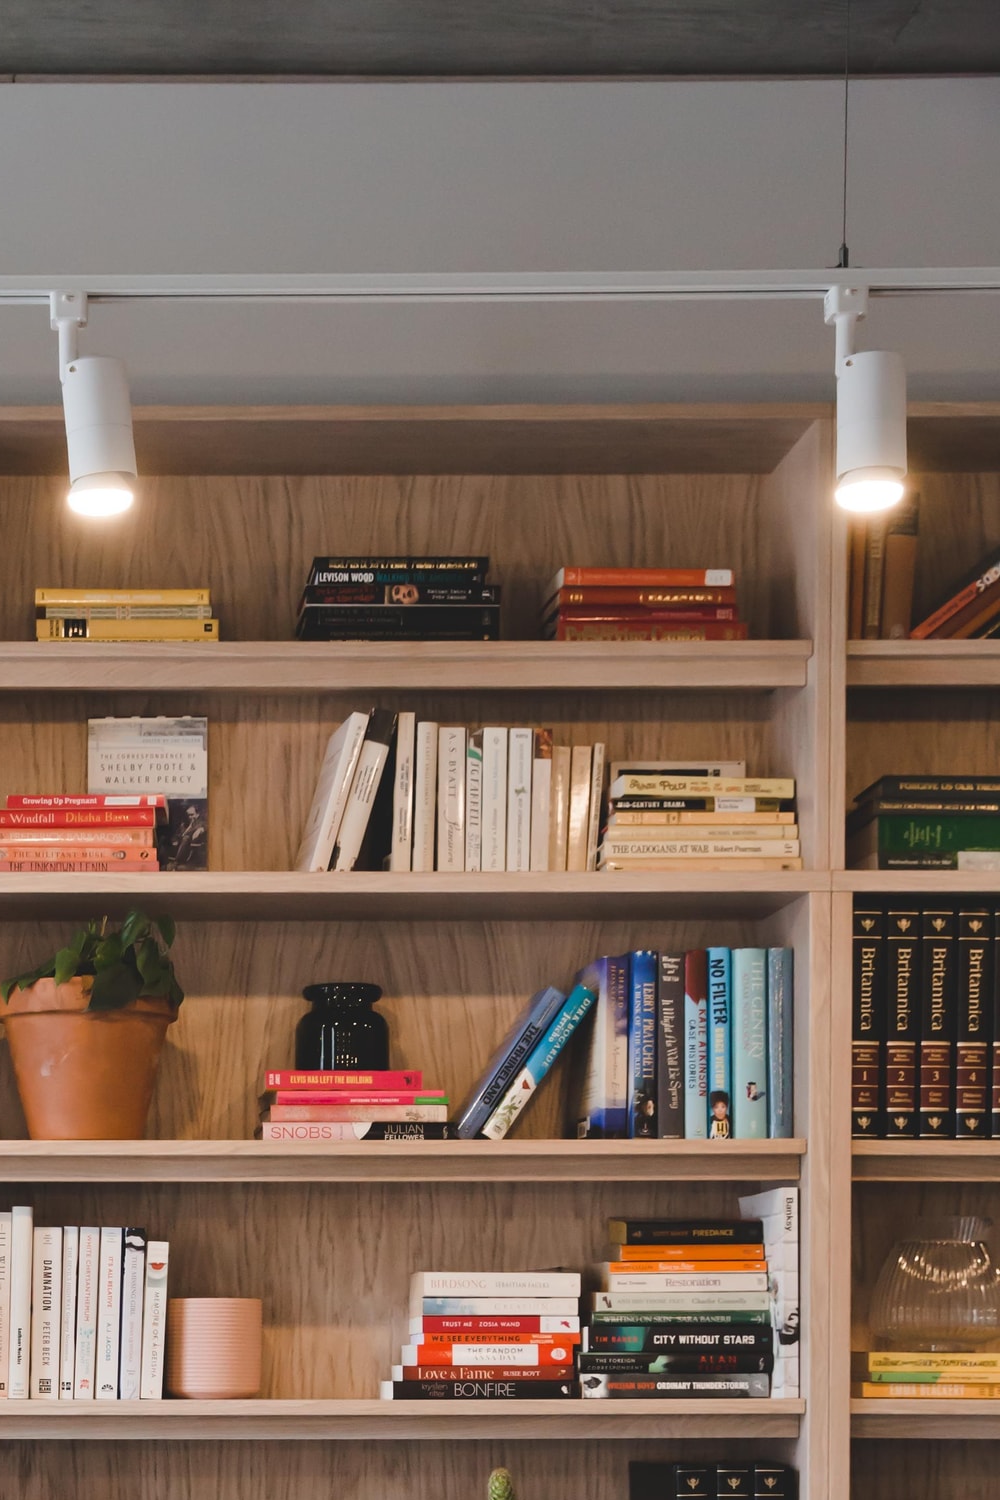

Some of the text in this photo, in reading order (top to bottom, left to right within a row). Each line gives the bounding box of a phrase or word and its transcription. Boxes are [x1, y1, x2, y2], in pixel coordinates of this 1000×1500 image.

[319, 573, 374, 582] LEVISON WOOD
[10, 813, 54, 824] Windfall
[22, 797, 97, 806] Growing Up Pregnant
[612, 845, 629, 854] THE
[631, 845, 677, 853] CADOGANS
[710, 959, 728, 1025] NO FILTER
[860, 947, 875, 1030] Britannica
[896, 948, 911, 1030] Britannica
[931, 947, 946, 1030] Britannica
[968, 949, 984, 1032] Britannica
[542, 998, 591, 1068] DIRK BOGARDE
[548, 1012, 570, 1043] Jericho
[642, 982, 654, 1080] TERRY PRATCHETT
[482, 1025, 539, 1105] THE RHINELAND
[271, 1126, 332, 1138] SNOBS
[384, 1124, 424, 1133] JULIAN
[784, 1197, 794, 1231] Banksy
[42, 1260, 52, 1311] DAMNATION
[42, 1321, 50, 1366] PETER BECK
[653, 1335, 755, 1344] CITY WITHOUT STARS
[454, 1382, 516, 1396] BONFIRE
